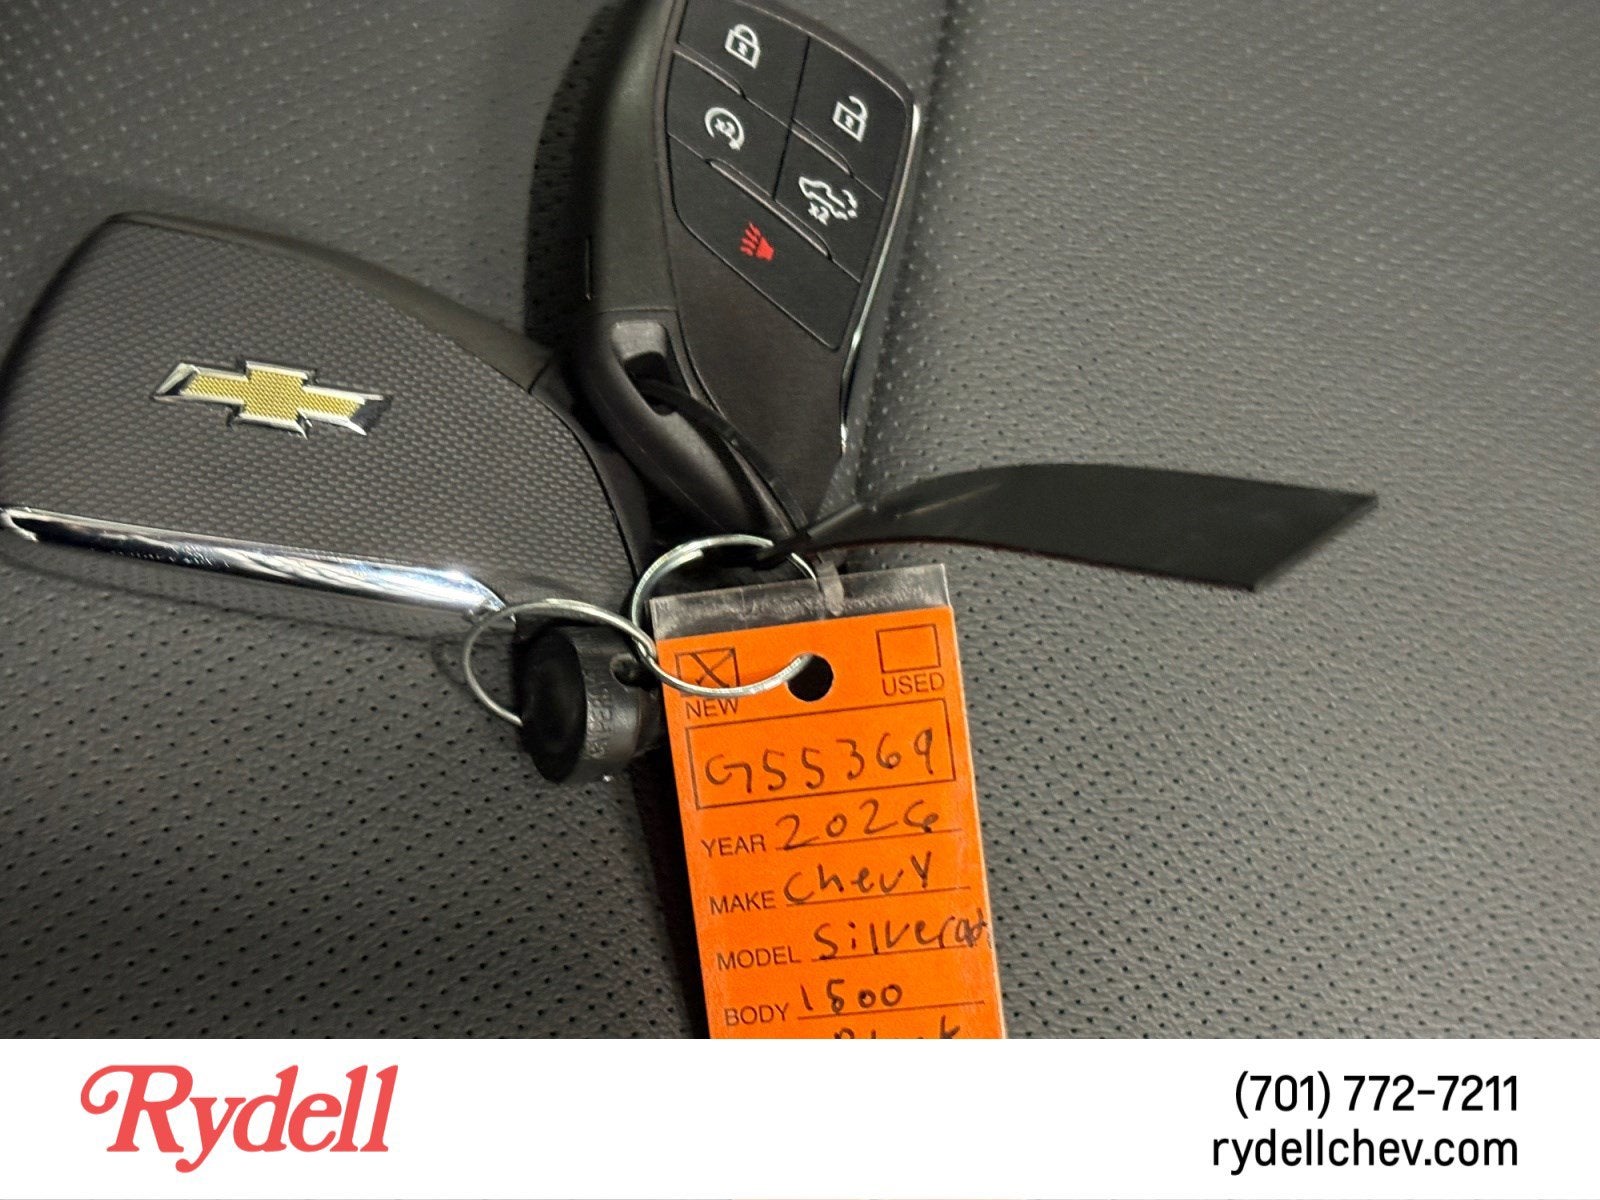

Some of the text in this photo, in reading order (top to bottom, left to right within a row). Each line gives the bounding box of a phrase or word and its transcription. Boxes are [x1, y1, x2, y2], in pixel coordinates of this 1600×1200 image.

[882, 673, 945, 697] USED
[685, 699, 739, 719] NEW
[705, 728, 934, 793] G55369
[775, 799, 939, 851] 2026
[702, 834, 767, 858] YEAR
[709, 890, 776, 915] MAKE
[717, 945, 802, 971] MODEL
[801, 978, 903, 1014] 1500
[724, 1003, 789, 1027] BODY
